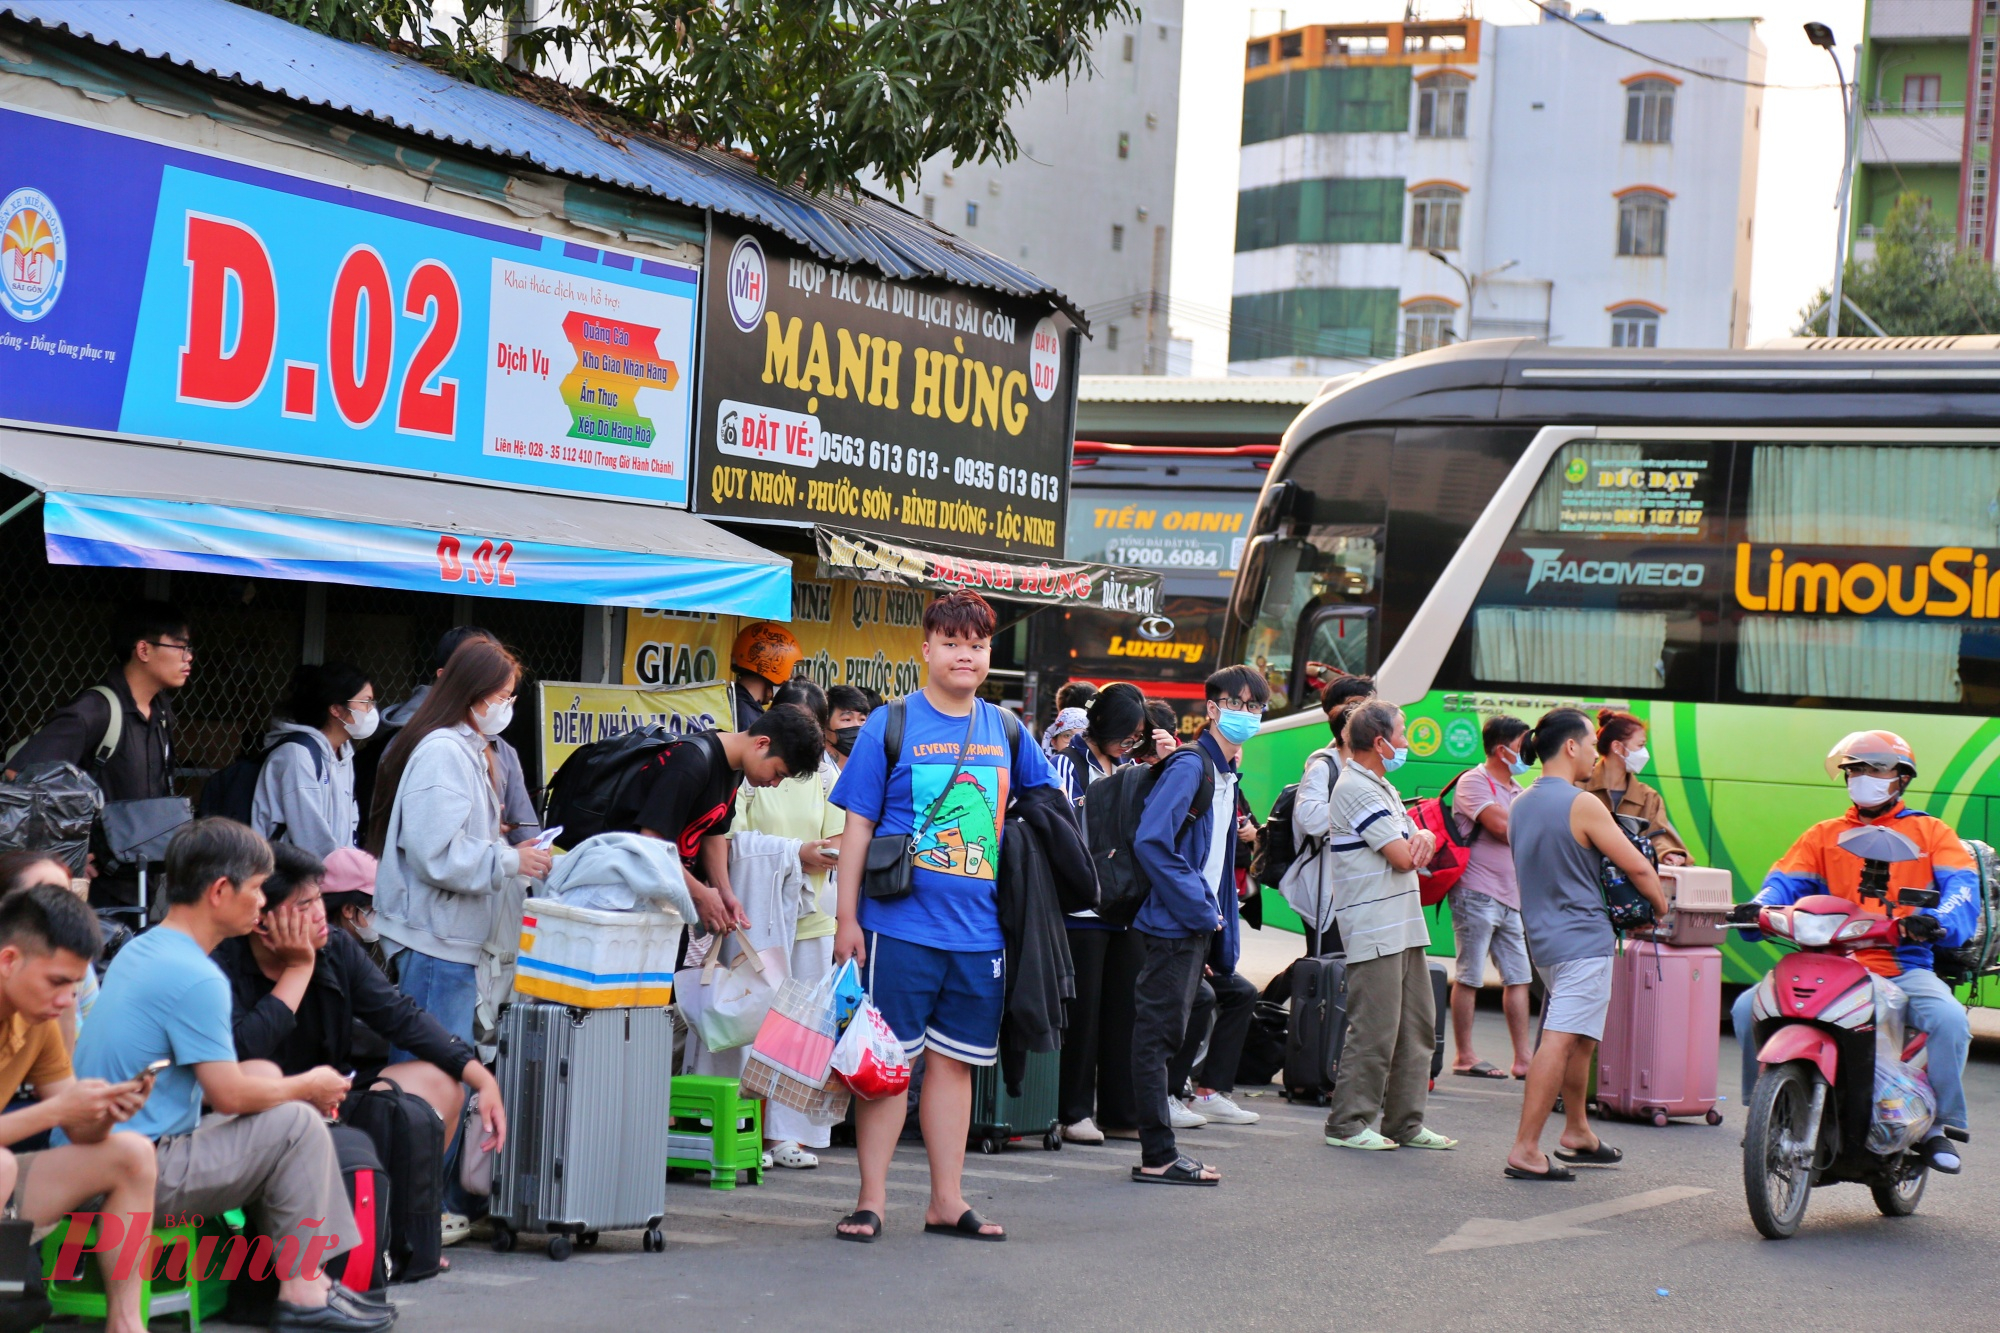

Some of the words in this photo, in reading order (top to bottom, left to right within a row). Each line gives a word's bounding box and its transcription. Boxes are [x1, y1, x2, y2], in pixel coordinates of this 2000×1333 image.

[504, 269, 527, 289] Khai
[530, 275, 551, 294] thác
[554, 280, 574, 301] dịch
[577, 291, 588, 305] vụ
[788, 257, 826, 298] HỢP
[830, 264, 862, 304] TÁC
[865, 276, 889, 311] XÃ
[891, 286, 914, 318] DU
[918, 293, 951, 328] LỊCH
[955, 300, 979, 335] SÀI
[982, 307, 1016, 345] GÒN
[176, 209, 462, 441] D.02
[583, 321, 610, 345] Quảng
[58, 339, 79, 359] lòng
[79, 343, 103, 361] phục
[105, 350, 116, 364] vụ
[497, 343, 527, 375] Dịch
[532, 348, 549, 380] Vụ
[582, 351, 599, 370] Kho
[602, 355, 621, 374] Giao
[622, 359, 644, 382] Nhận
[762, 311, 902, 414] MẠNH
[911, 336, 1028, 436] HÙNG
[1035, 362, 1054, 391] D.01
[598, 388, 618, 410] Thực
[611, 421, 633, 442] Hàng
[742, 413, 779, 457] ĐẶT
[785, 421, 814, 458] VÉ:
[495, 437, 511, 453] Liên
[513, 439, 526, 458] Hệ:
[528, 442, 543, 458] 028
[550, 445, 560, 459] 35
[562, 447, 576, 462] 112
[578, 449, 592, 464] 410
[594, 451, 617, 470] (Trong
[631, 457, 649, 472] Hành
[819, 431, 865, 467] 0563
[869, 441, 902, 474] 613
[906, 448, 939, 480] 613
[954, 457, 995, 490] 0935
[998, 465, 1027, 497] 613
[1031, 472, 1059, 503] 613
[711, 465, 747, 504] QUY
[750, 469, 797, 507] NHƠN
[807, 476, 860, 516] PHƯỚC
[861, 485, 892, 521] SƠN
[901, 488, 937, 528] BÌNH
[939, 499, 987, 536] DƯƠNG
[996, 504, 1021, 548] LỘC
[1023, 515, 1056, 547] NINH
[1093, 503, 1157, 529] TIẾN
[1162, 511, 1244, 533] OANH
[436, 534, 516, 587] D.02
[1117, 547, 1218, 567] 1900.6084
[1521, 547, 1705, 595] TRACOMECO
[929, 553, 1013, 589] MẠNH
[1019, 562, 1092, 600] HÙNG
[852, 585, 882, 629] QUY
[635, 641, 717, 685] GIAO
[1107, 636, 1204, 663] Luxury
[553, 695, 593, 744] ĐIỂM
[913, 743, 960, 757] LEVENTS
